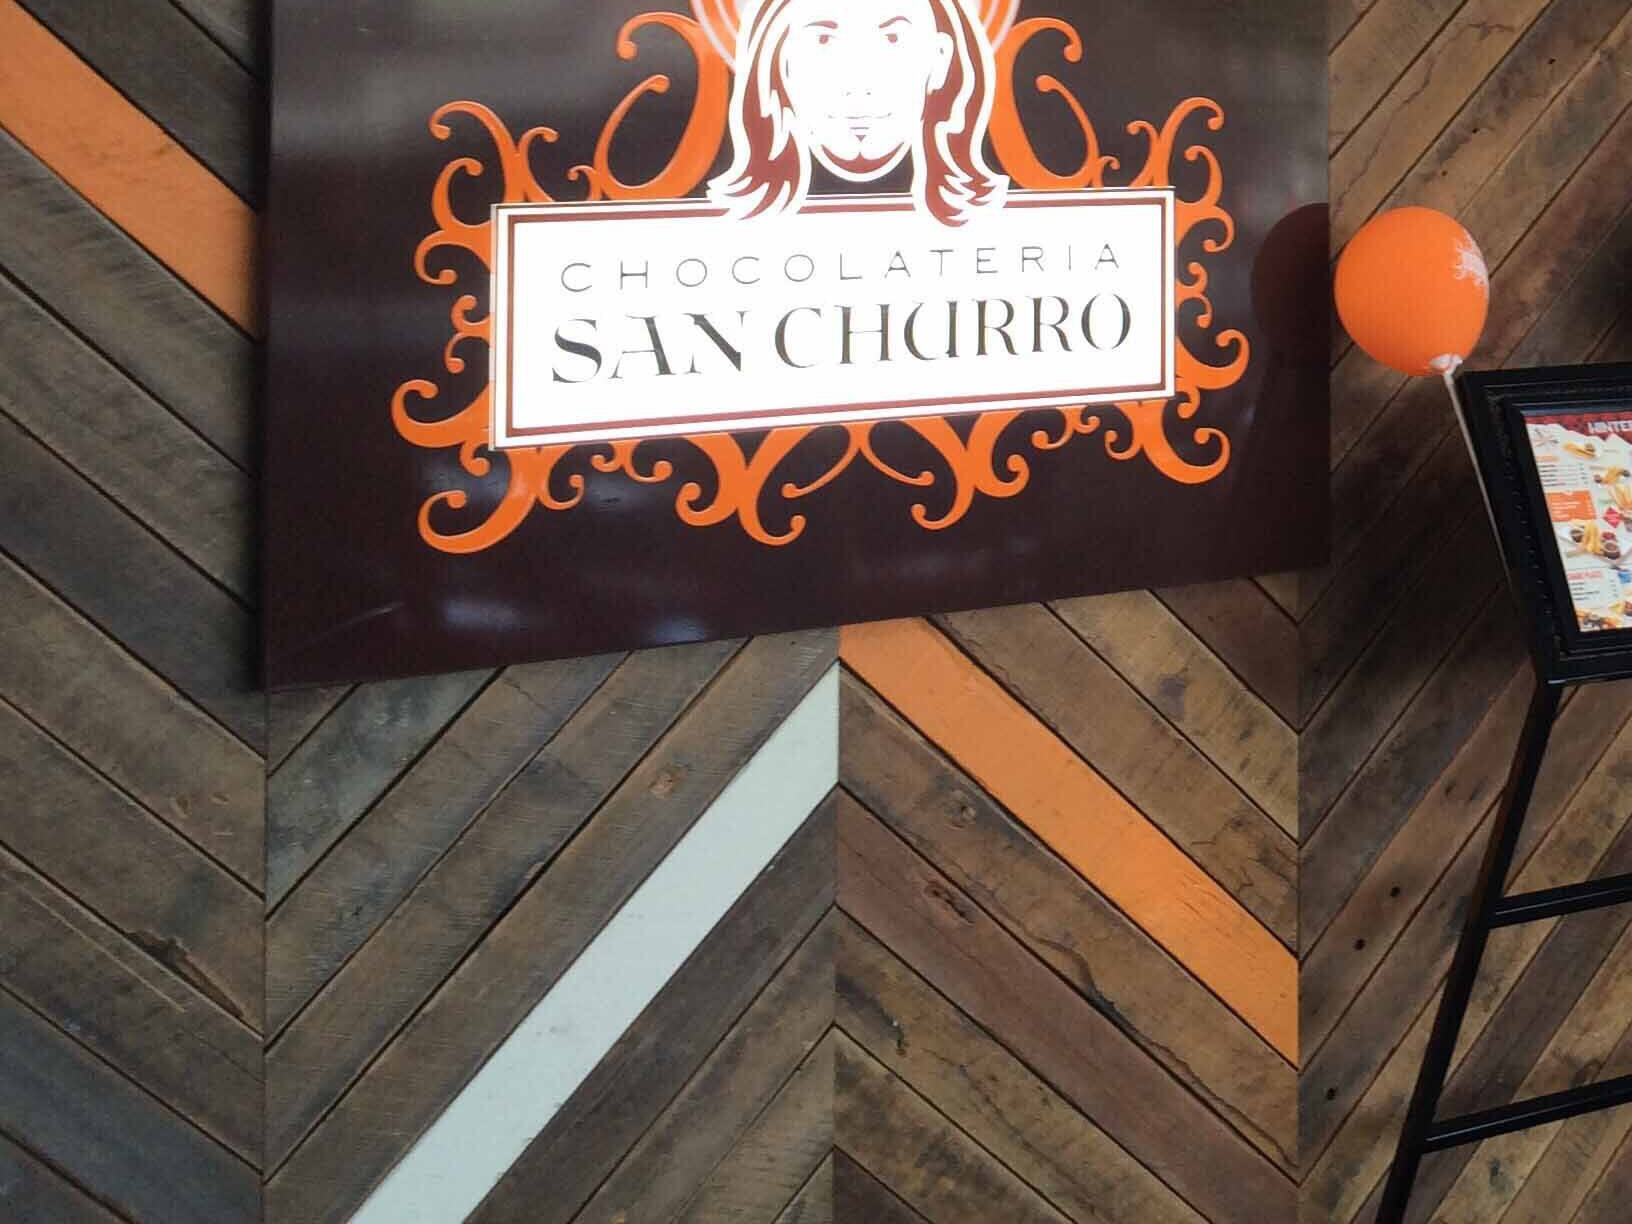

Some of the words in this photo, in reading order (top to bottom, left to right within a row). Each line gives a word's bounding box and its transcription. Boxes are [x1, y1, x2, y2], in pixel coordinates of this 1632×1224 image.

[561, 243, 1121, 293] CHOCOLATERIA
[552, 310, 747, 384] SAN
[774, 291, 1133, 370] CHURRO
